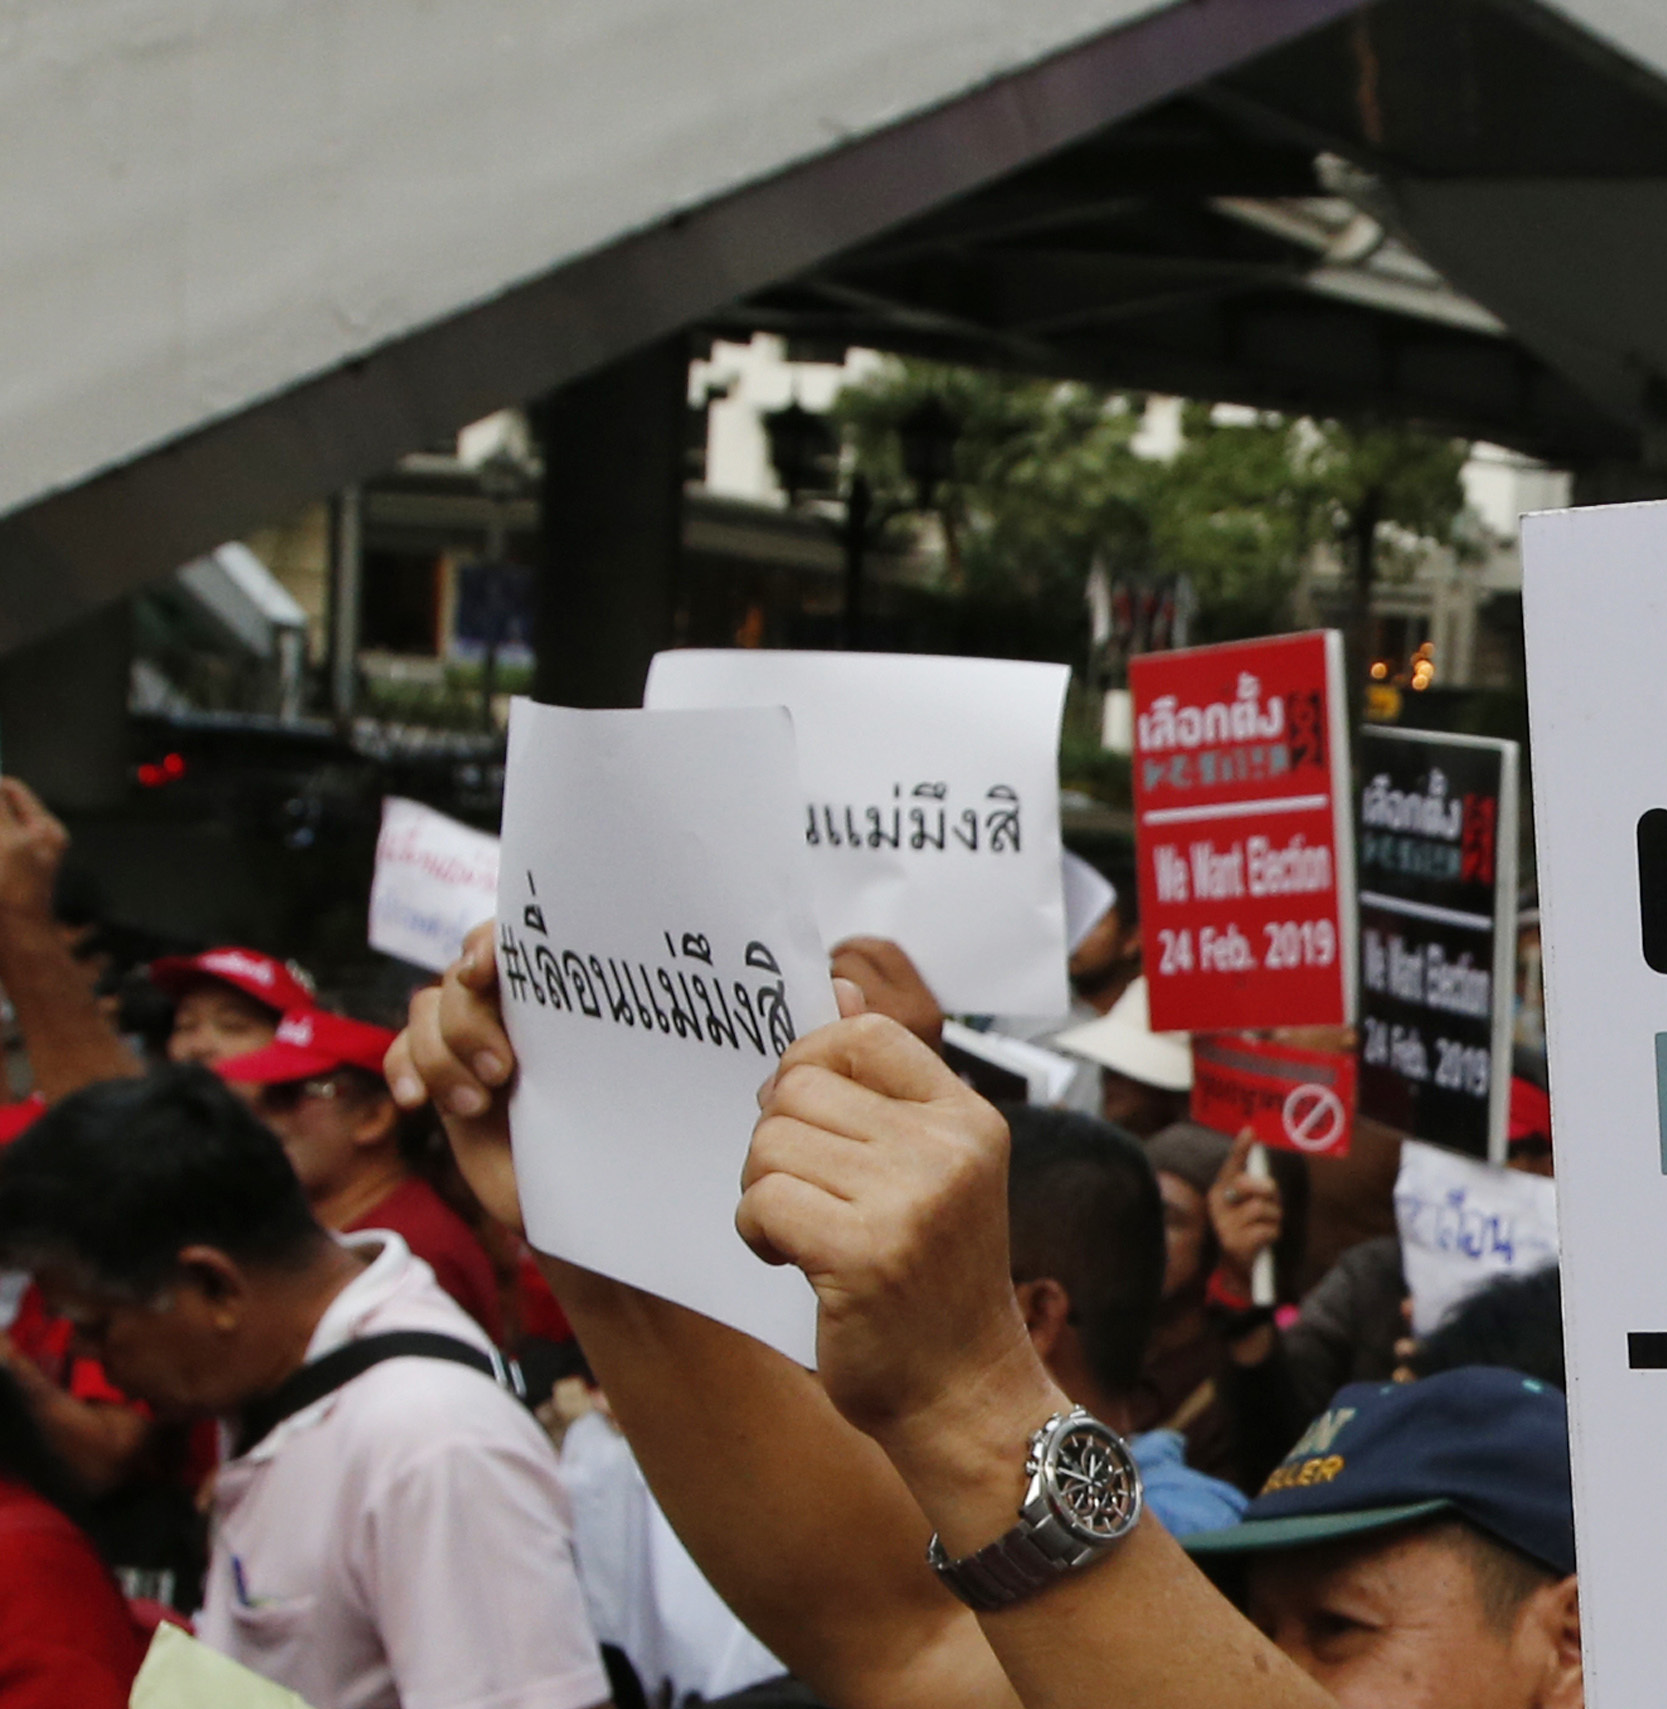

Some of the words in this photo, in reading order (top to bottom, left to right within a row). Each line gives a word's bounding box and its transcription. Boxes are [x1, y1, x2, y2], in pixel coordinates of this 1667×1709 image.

[1137, 671, 1285, 752] เลือกตั้ง
[1152, 842, 1188, 903] We
[1189, 838, 1245, 902] Want
[1248, 833, 1333, 898] Election
[501, 870, 797, 1058] #เลื่อนแม่มึงสิ
[1157, 927, 1195, 976] 24
[1198, 923, 1255, 973] Feb.
[1263, 918, 1337, 972] 2019
